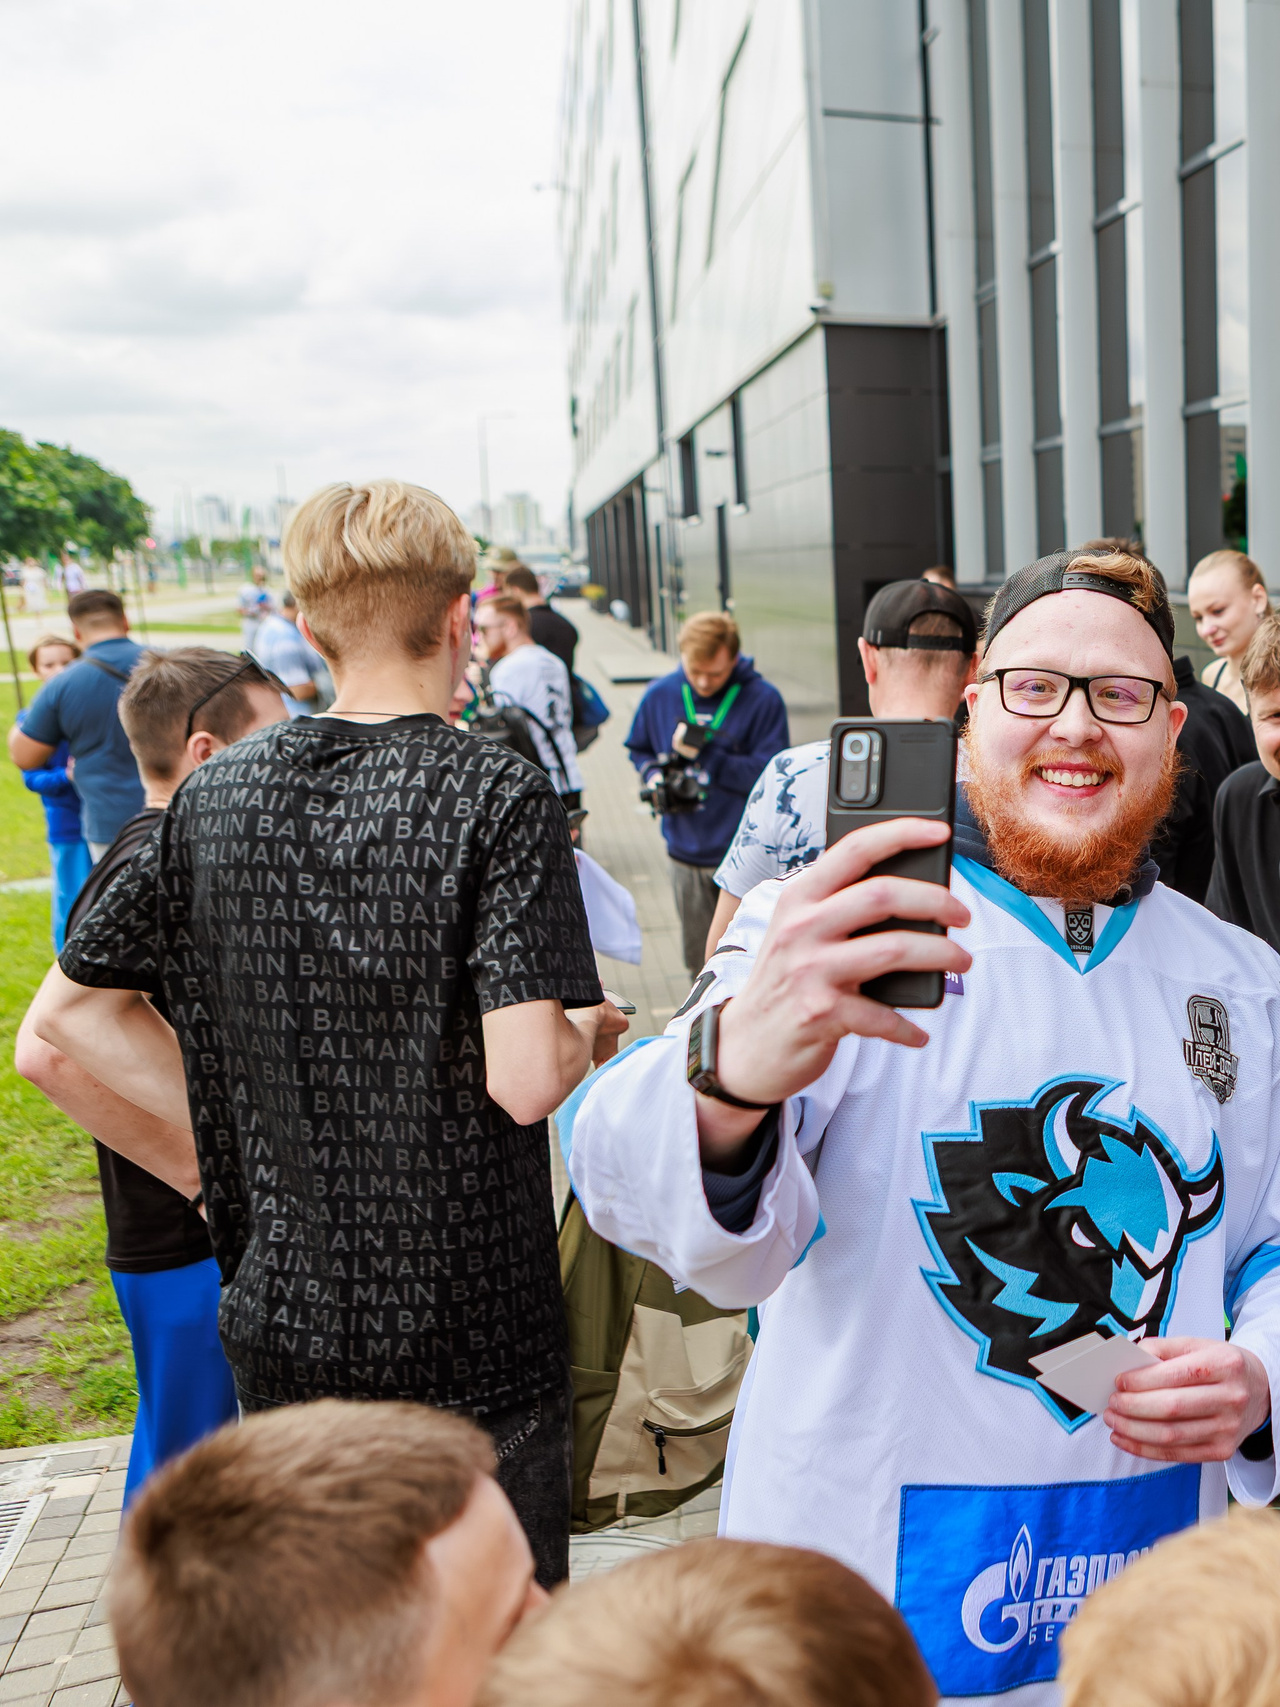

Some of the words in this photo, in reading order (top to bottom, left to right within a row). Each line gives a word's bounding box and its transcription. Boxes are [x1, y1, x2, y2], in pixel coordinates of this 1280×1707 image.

[331, 768, 467, 795] BALMAIN
[197, 787, 295, 813] BALMAIN
[304, 792, 442, 819] BALMAIN
[198, 841, 306, 870] BALMAIN
[314, 845, 448, 870] BALMAIN
[297, 872, 427, 898] BALMAIN
[252, 897, 378, 924] BALMAIN
[313, 926, 442, 952] BALMAIN
[300, 953, 427, 979] BALMAIN
[254, 980, 377, 1006] BALMAIN
[313, 1008, 442, 1036] BALMAIN
[301, 1036, 426, 1062] BALMAIN
[262, 1061, 383, 1088] BALMAIN
[314, 1091, 443, 1117] BALMAIN
[301, 1119, 429, 1144] BALMAIN
[312, 1174, 448, 1199] BALMAIN
[397, 1211, 531, 1252] BALMAIN
[304, 1279, 437, 1308] BALMAIN
[257, 1304, 384, 1335] BALMAIN
[309, 1335, 453, 1362] BALMAIN
[294, 1361, 437, 1387] BALMAIN
